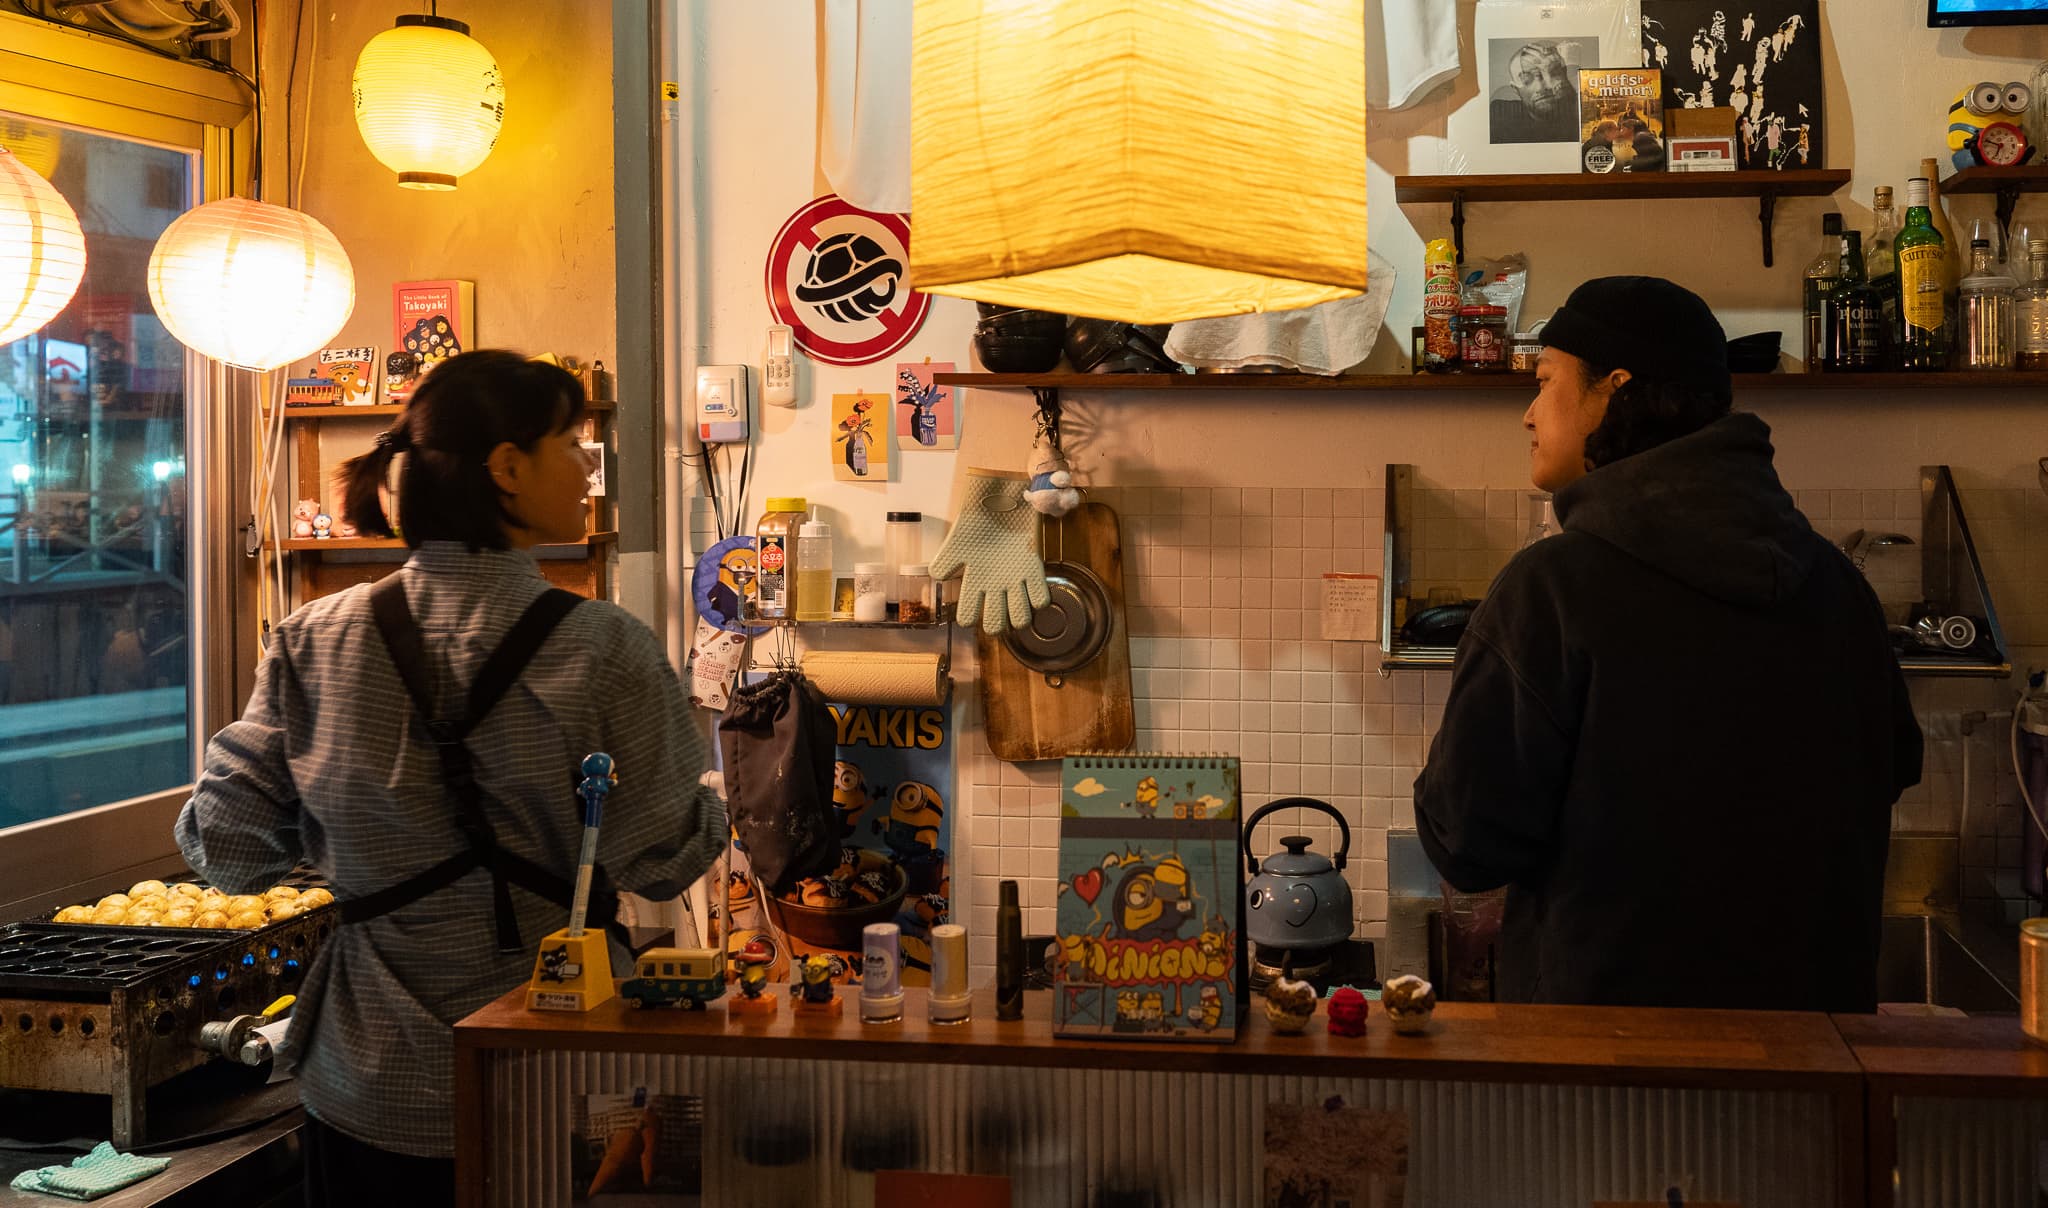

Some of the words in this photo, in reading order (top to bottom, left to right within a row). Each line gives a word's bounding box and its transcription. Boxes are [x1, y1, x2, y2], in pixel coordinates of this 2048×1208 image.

[1588, 74, 1644, 90] goldfish
[1599, 85, 1654, 97] memory
[1588, 155, 1613, 163] FREE!
[403, 299, 447, 313] Takoyaki
